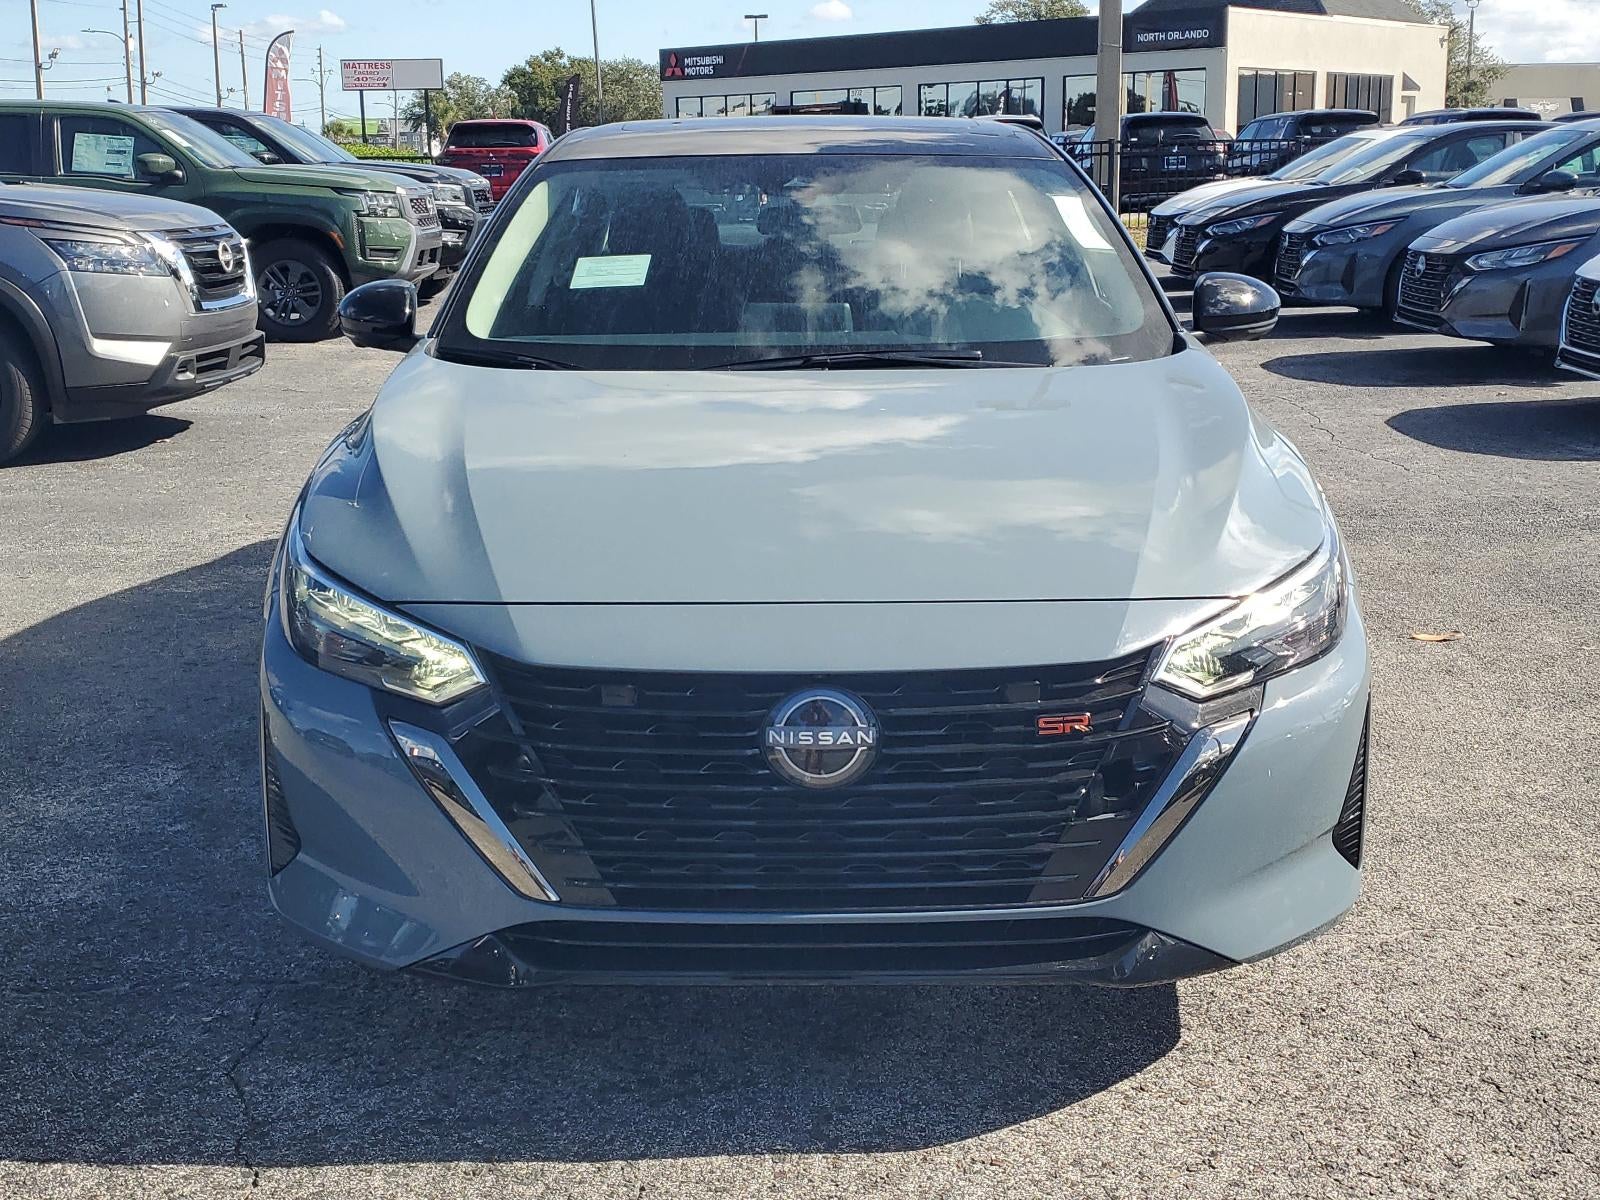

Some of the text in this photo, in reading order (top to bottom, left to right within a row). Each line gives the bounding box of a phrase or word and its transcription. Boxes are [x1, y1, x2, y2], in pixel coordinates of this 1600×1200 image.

[1137, 29, 1209, 42] NORTH ORLANDO
[343, 62, 391, 70] MATTRESS
[684, 55, 724, 66] MITSUBISHI
[684, 66, 714, 76] MOTORS
[1038, 714, 1092, 735] SR
[769, 730, 873, 745] NISSAN
